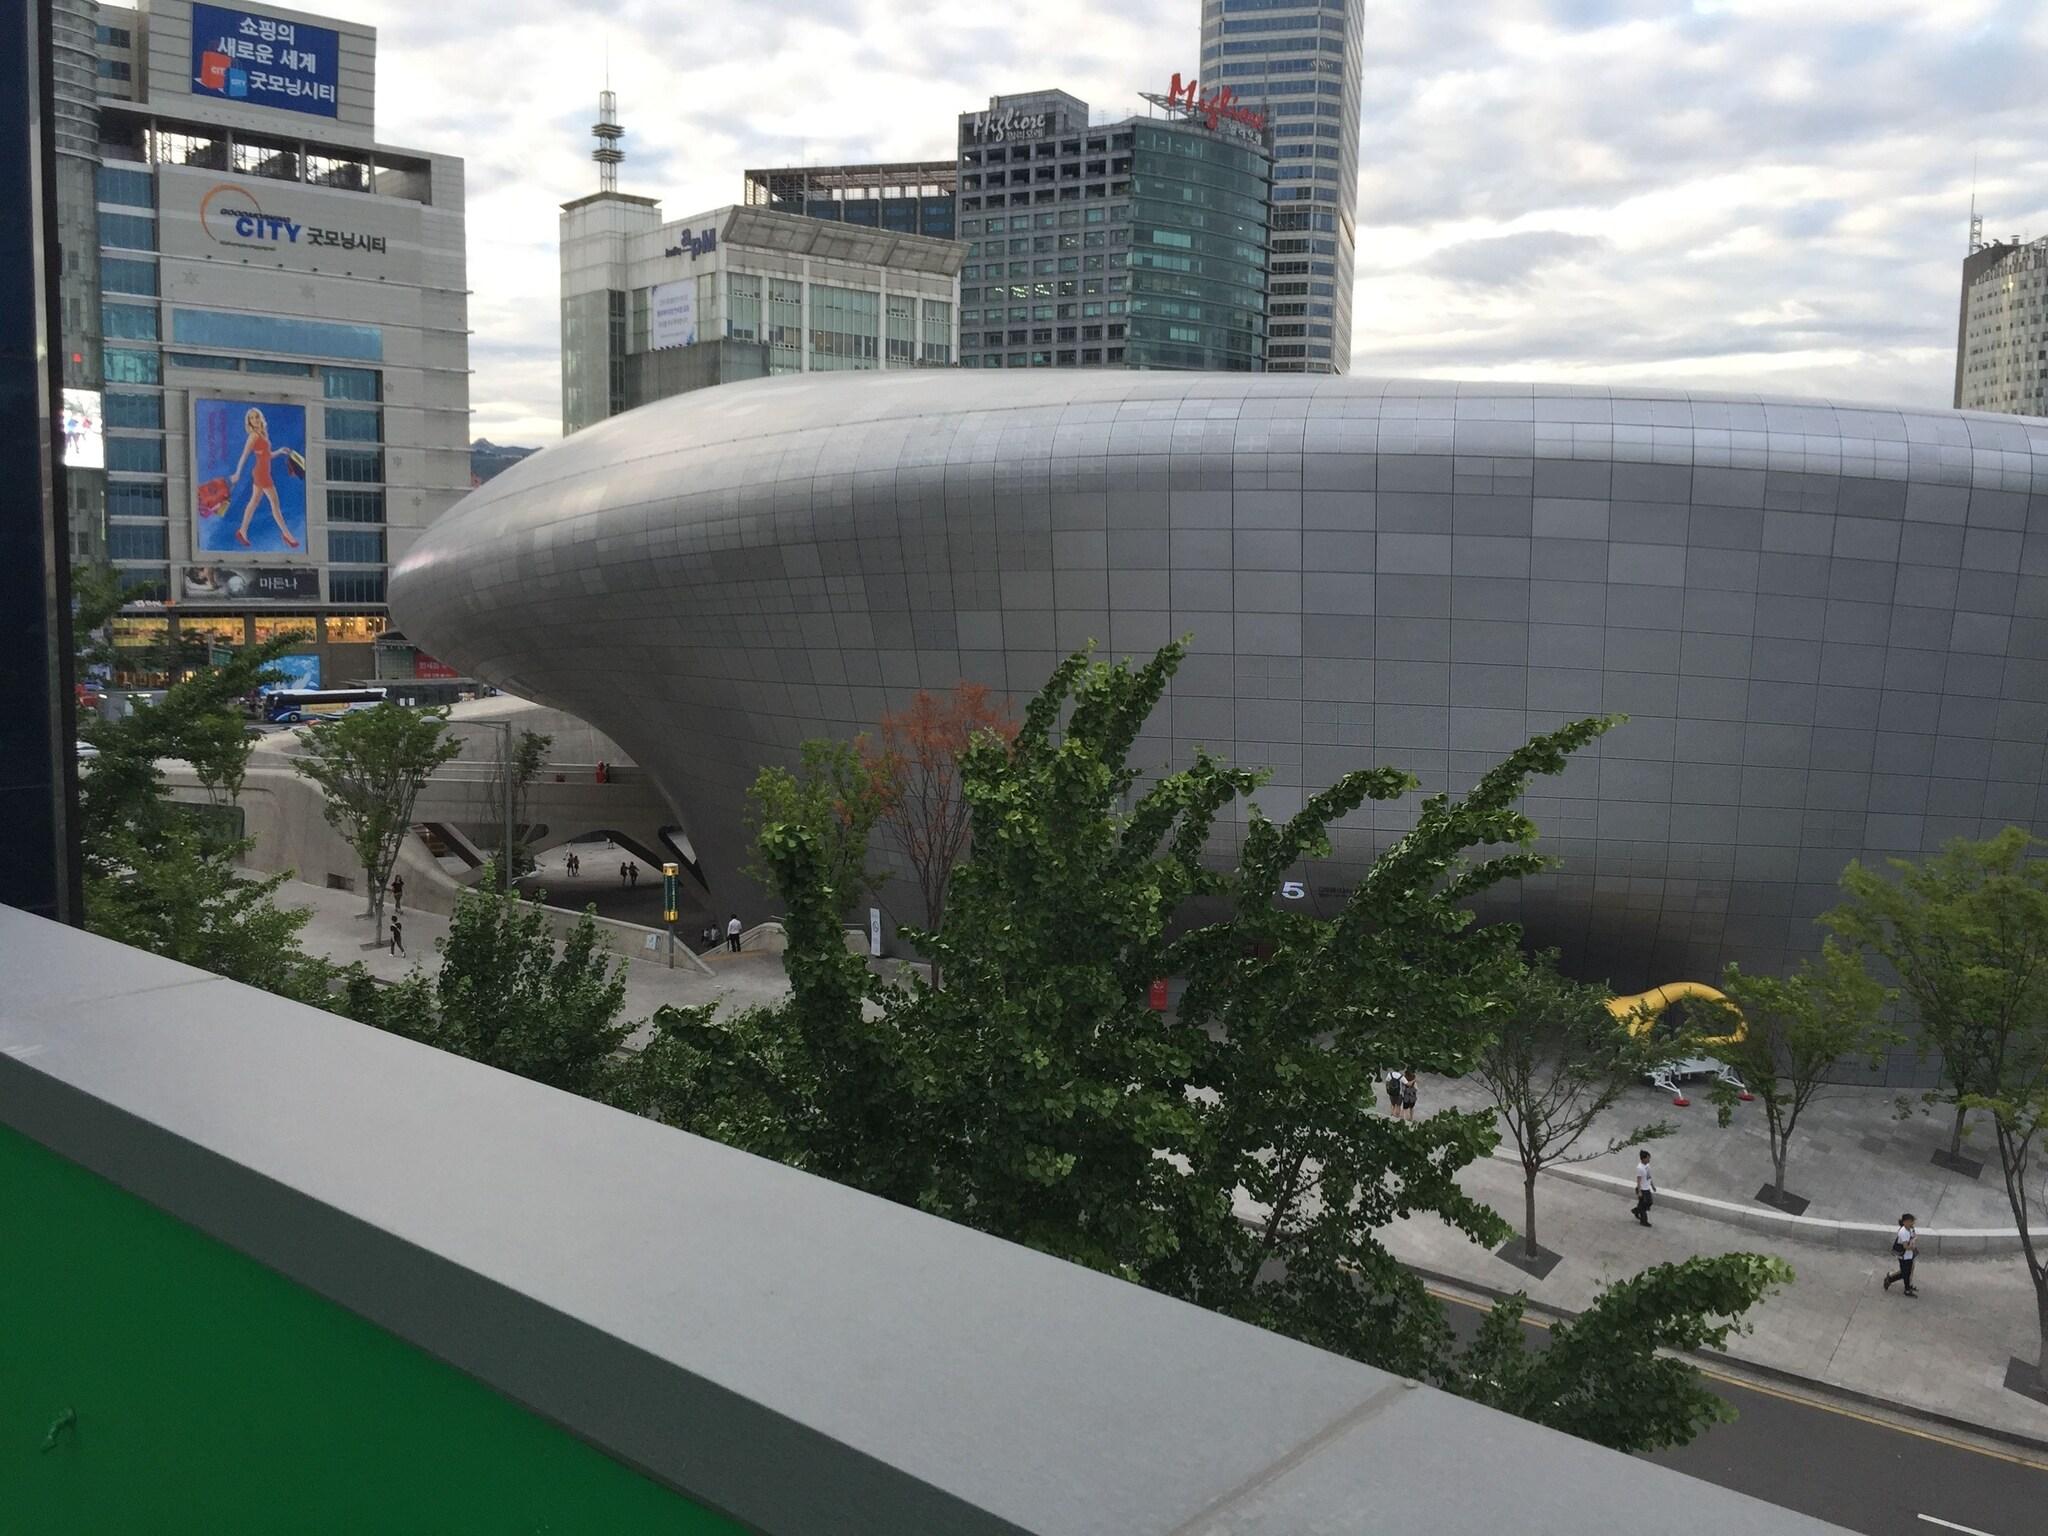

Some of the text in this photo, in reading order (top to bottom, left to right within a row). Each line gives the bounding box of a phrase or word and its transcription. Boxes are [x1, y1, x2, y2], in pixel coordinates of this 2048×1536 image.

[239, 17, 295, 46] 쇼핑의
[217, 36, 316, 74] 새로운 세계
[249, 70, 335, 103] 굿모닝시티
[973, 107, 1046, 142] Migliore
[235, 216, 302, 243] CITY
[307, 226, 386, 254] 굿모닝시티
[1281, 881, 1305, 900] 5
